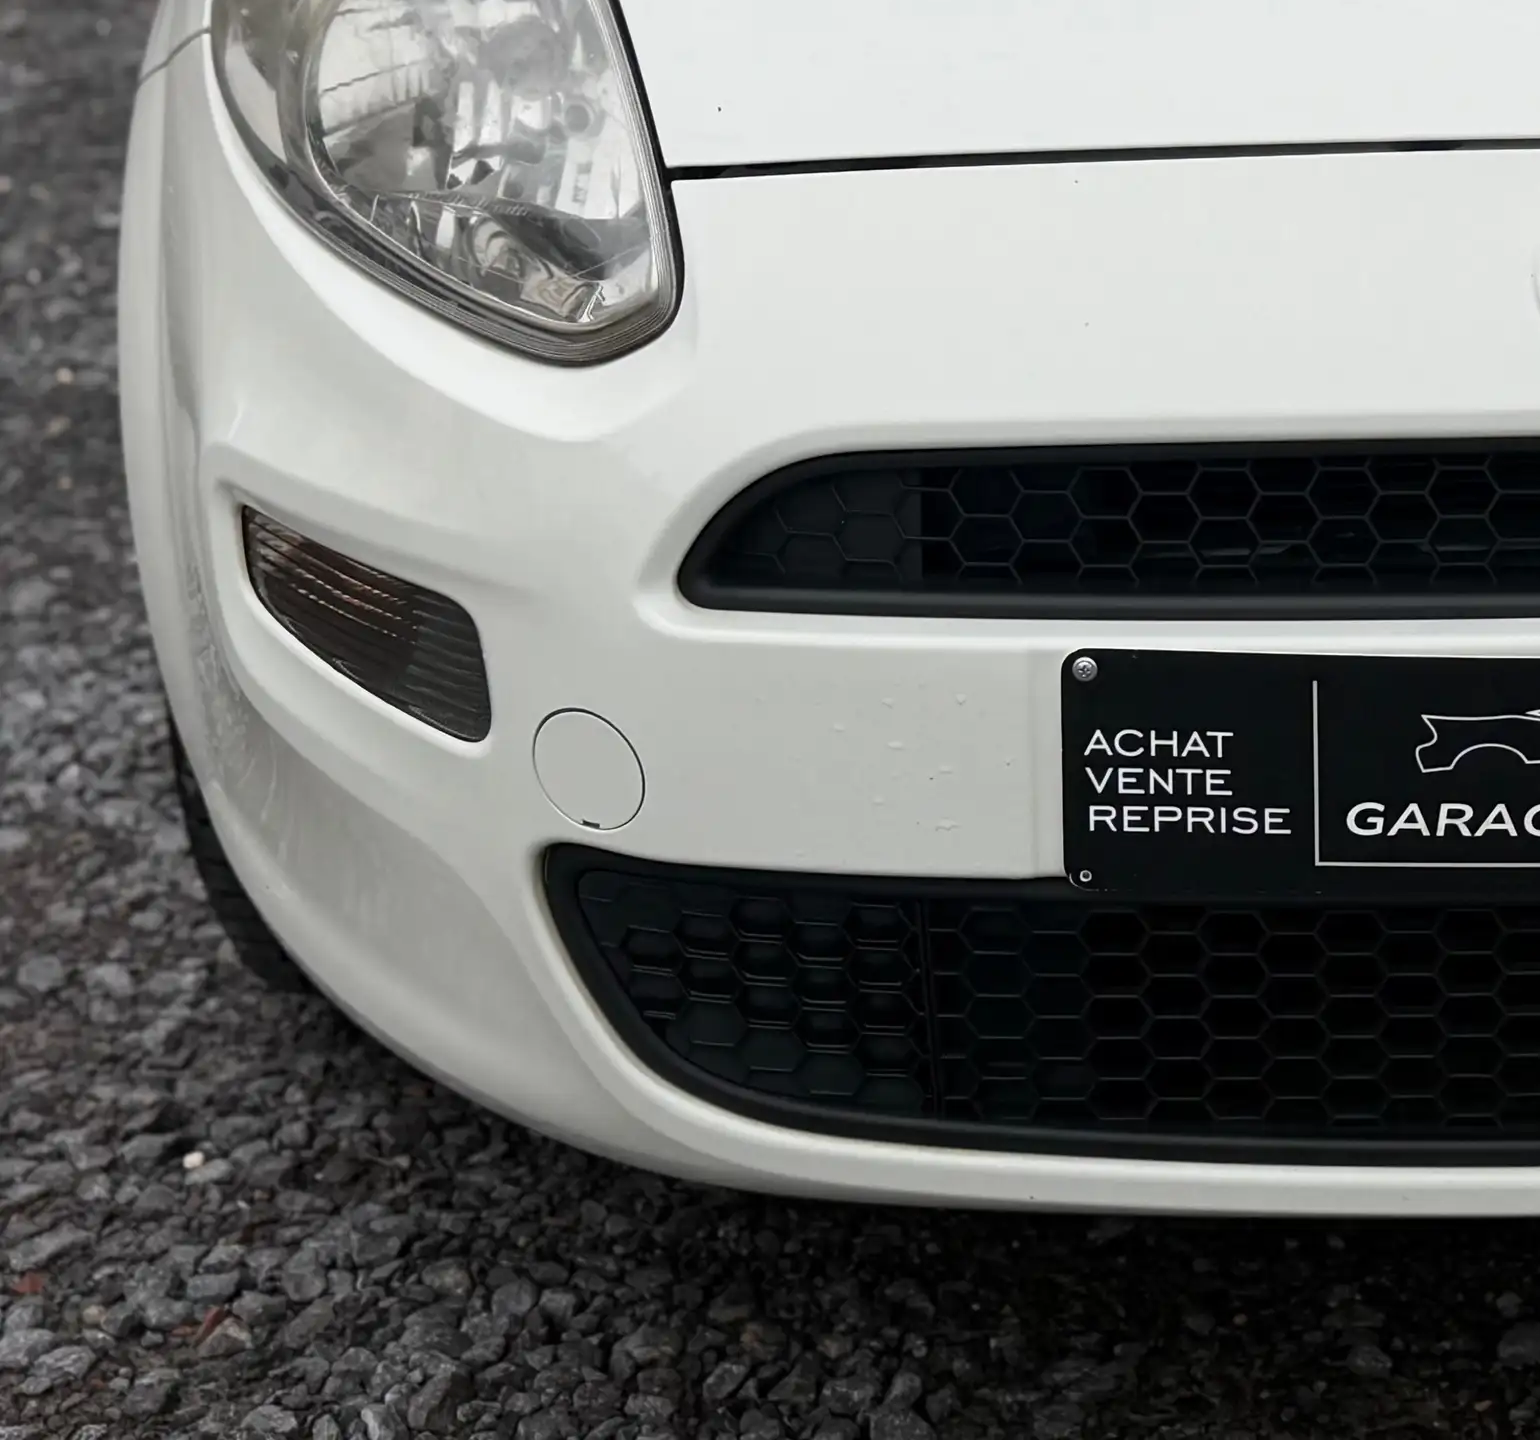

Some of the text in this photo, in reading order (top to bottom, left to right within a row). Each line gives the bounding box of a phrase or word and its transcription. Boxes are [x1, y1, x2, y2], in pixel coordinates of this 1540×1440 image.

[1083, 728, 1234, 758] ACHAT
[1084, 766, 1233, 796] VENTE
[1088, 804, 1292, 835] REPRISE
